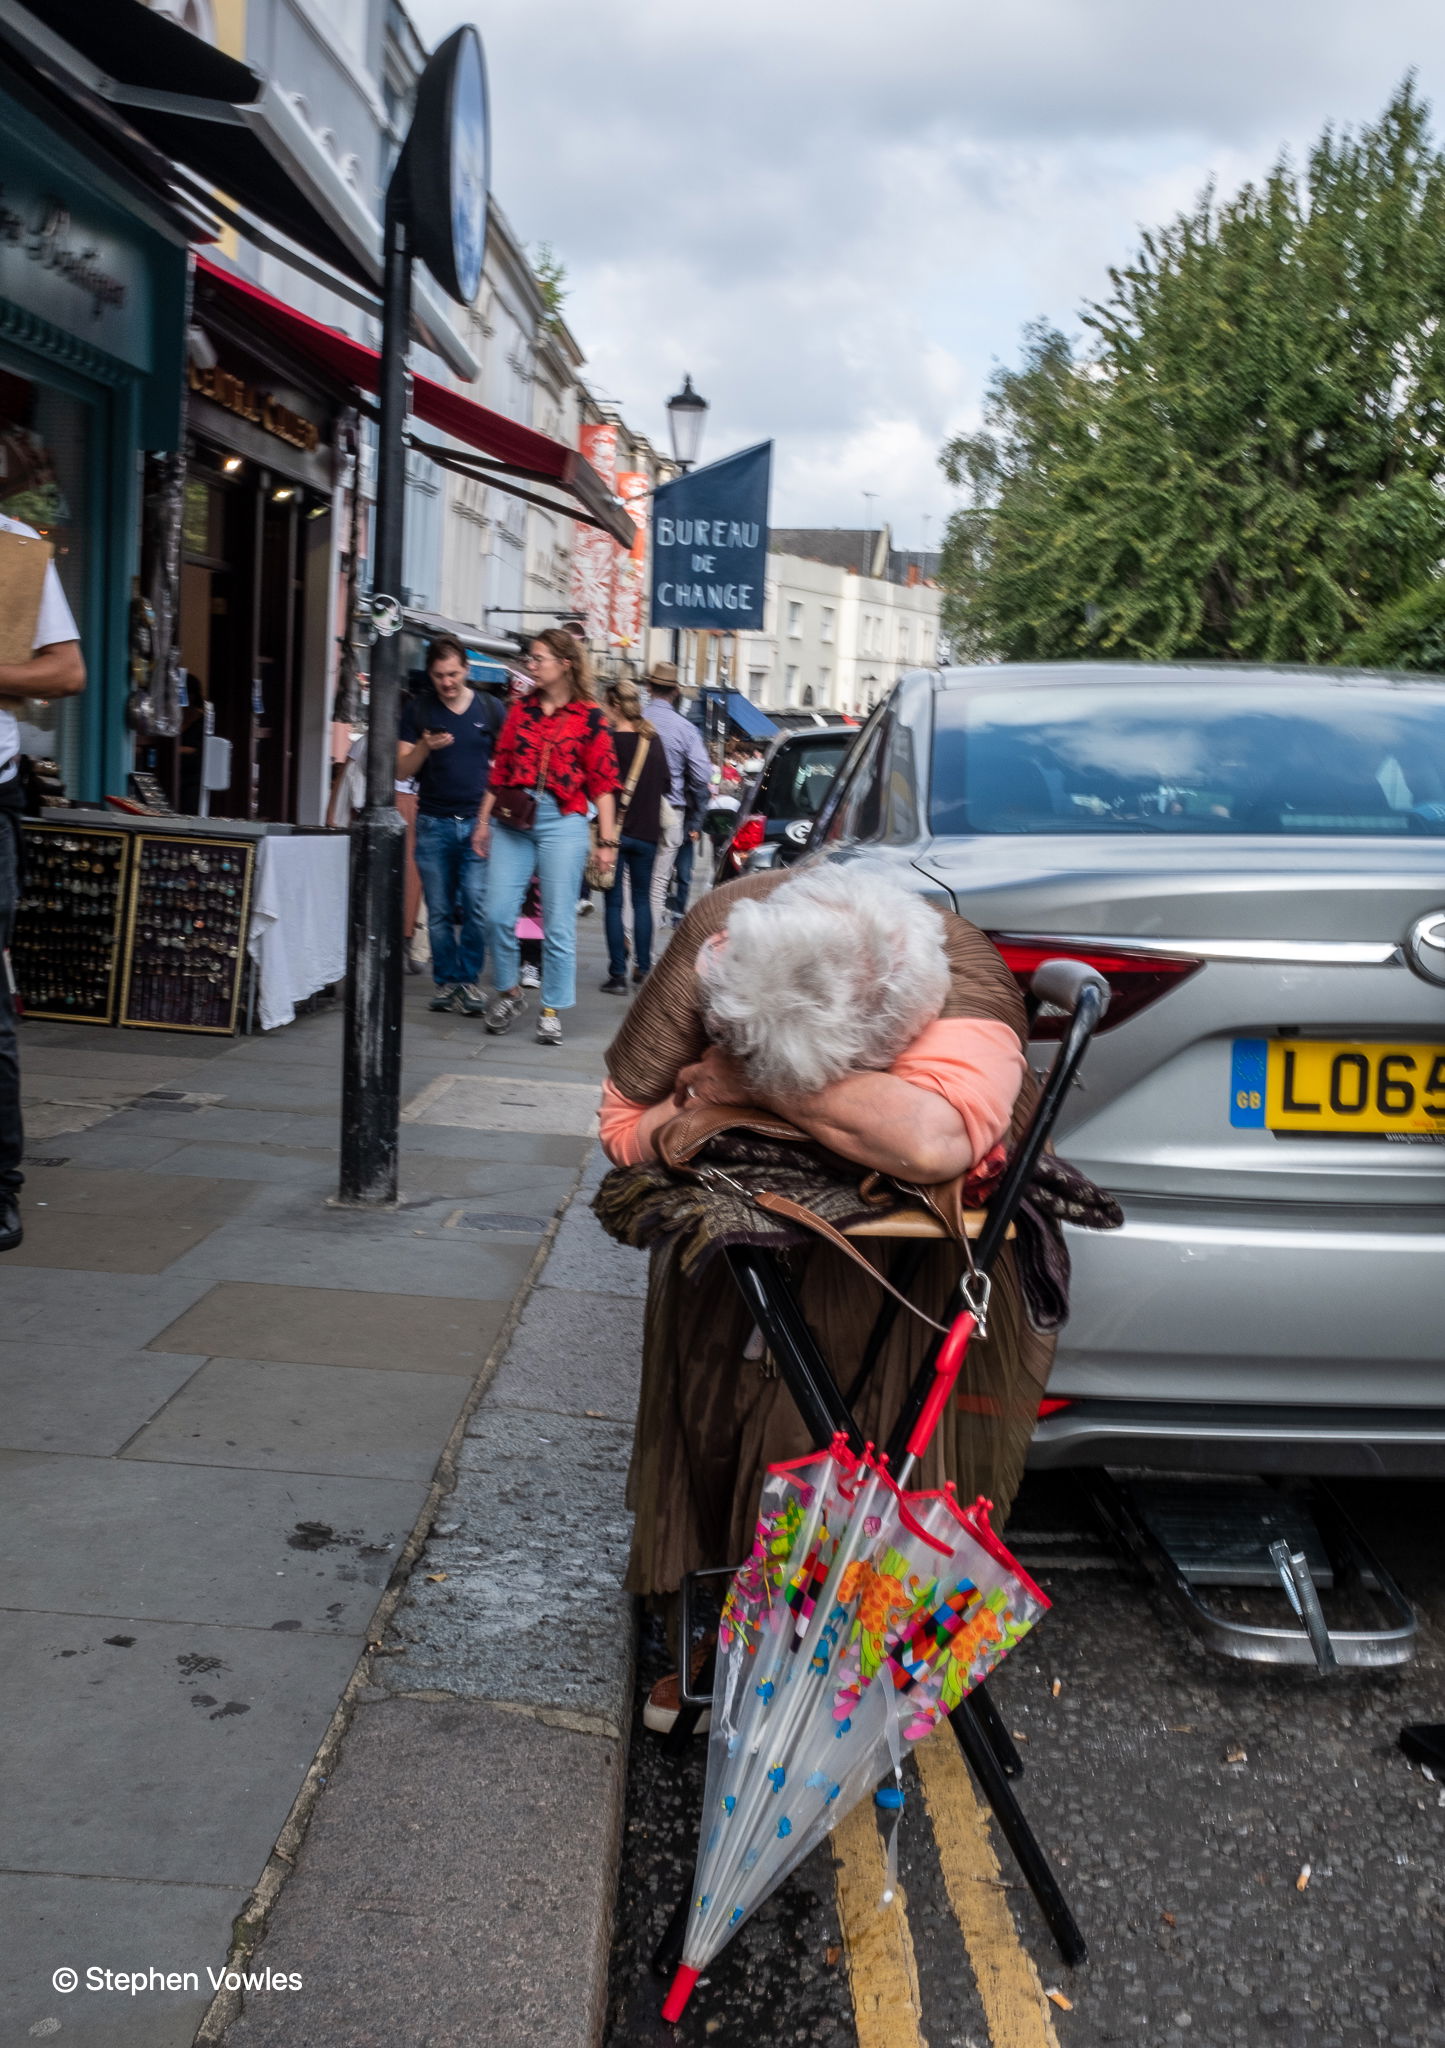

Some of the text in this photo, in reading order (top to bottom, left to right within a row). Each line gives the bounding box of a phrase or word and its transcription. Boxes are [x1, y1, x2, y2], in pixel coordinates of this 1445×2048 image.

[656, 517, 760, 548] BUREAU
[691, 554, 717, 574] DE
[656, 582, 754, 610] CHANGE
[1236, 1090, 1261, 1109] GB
